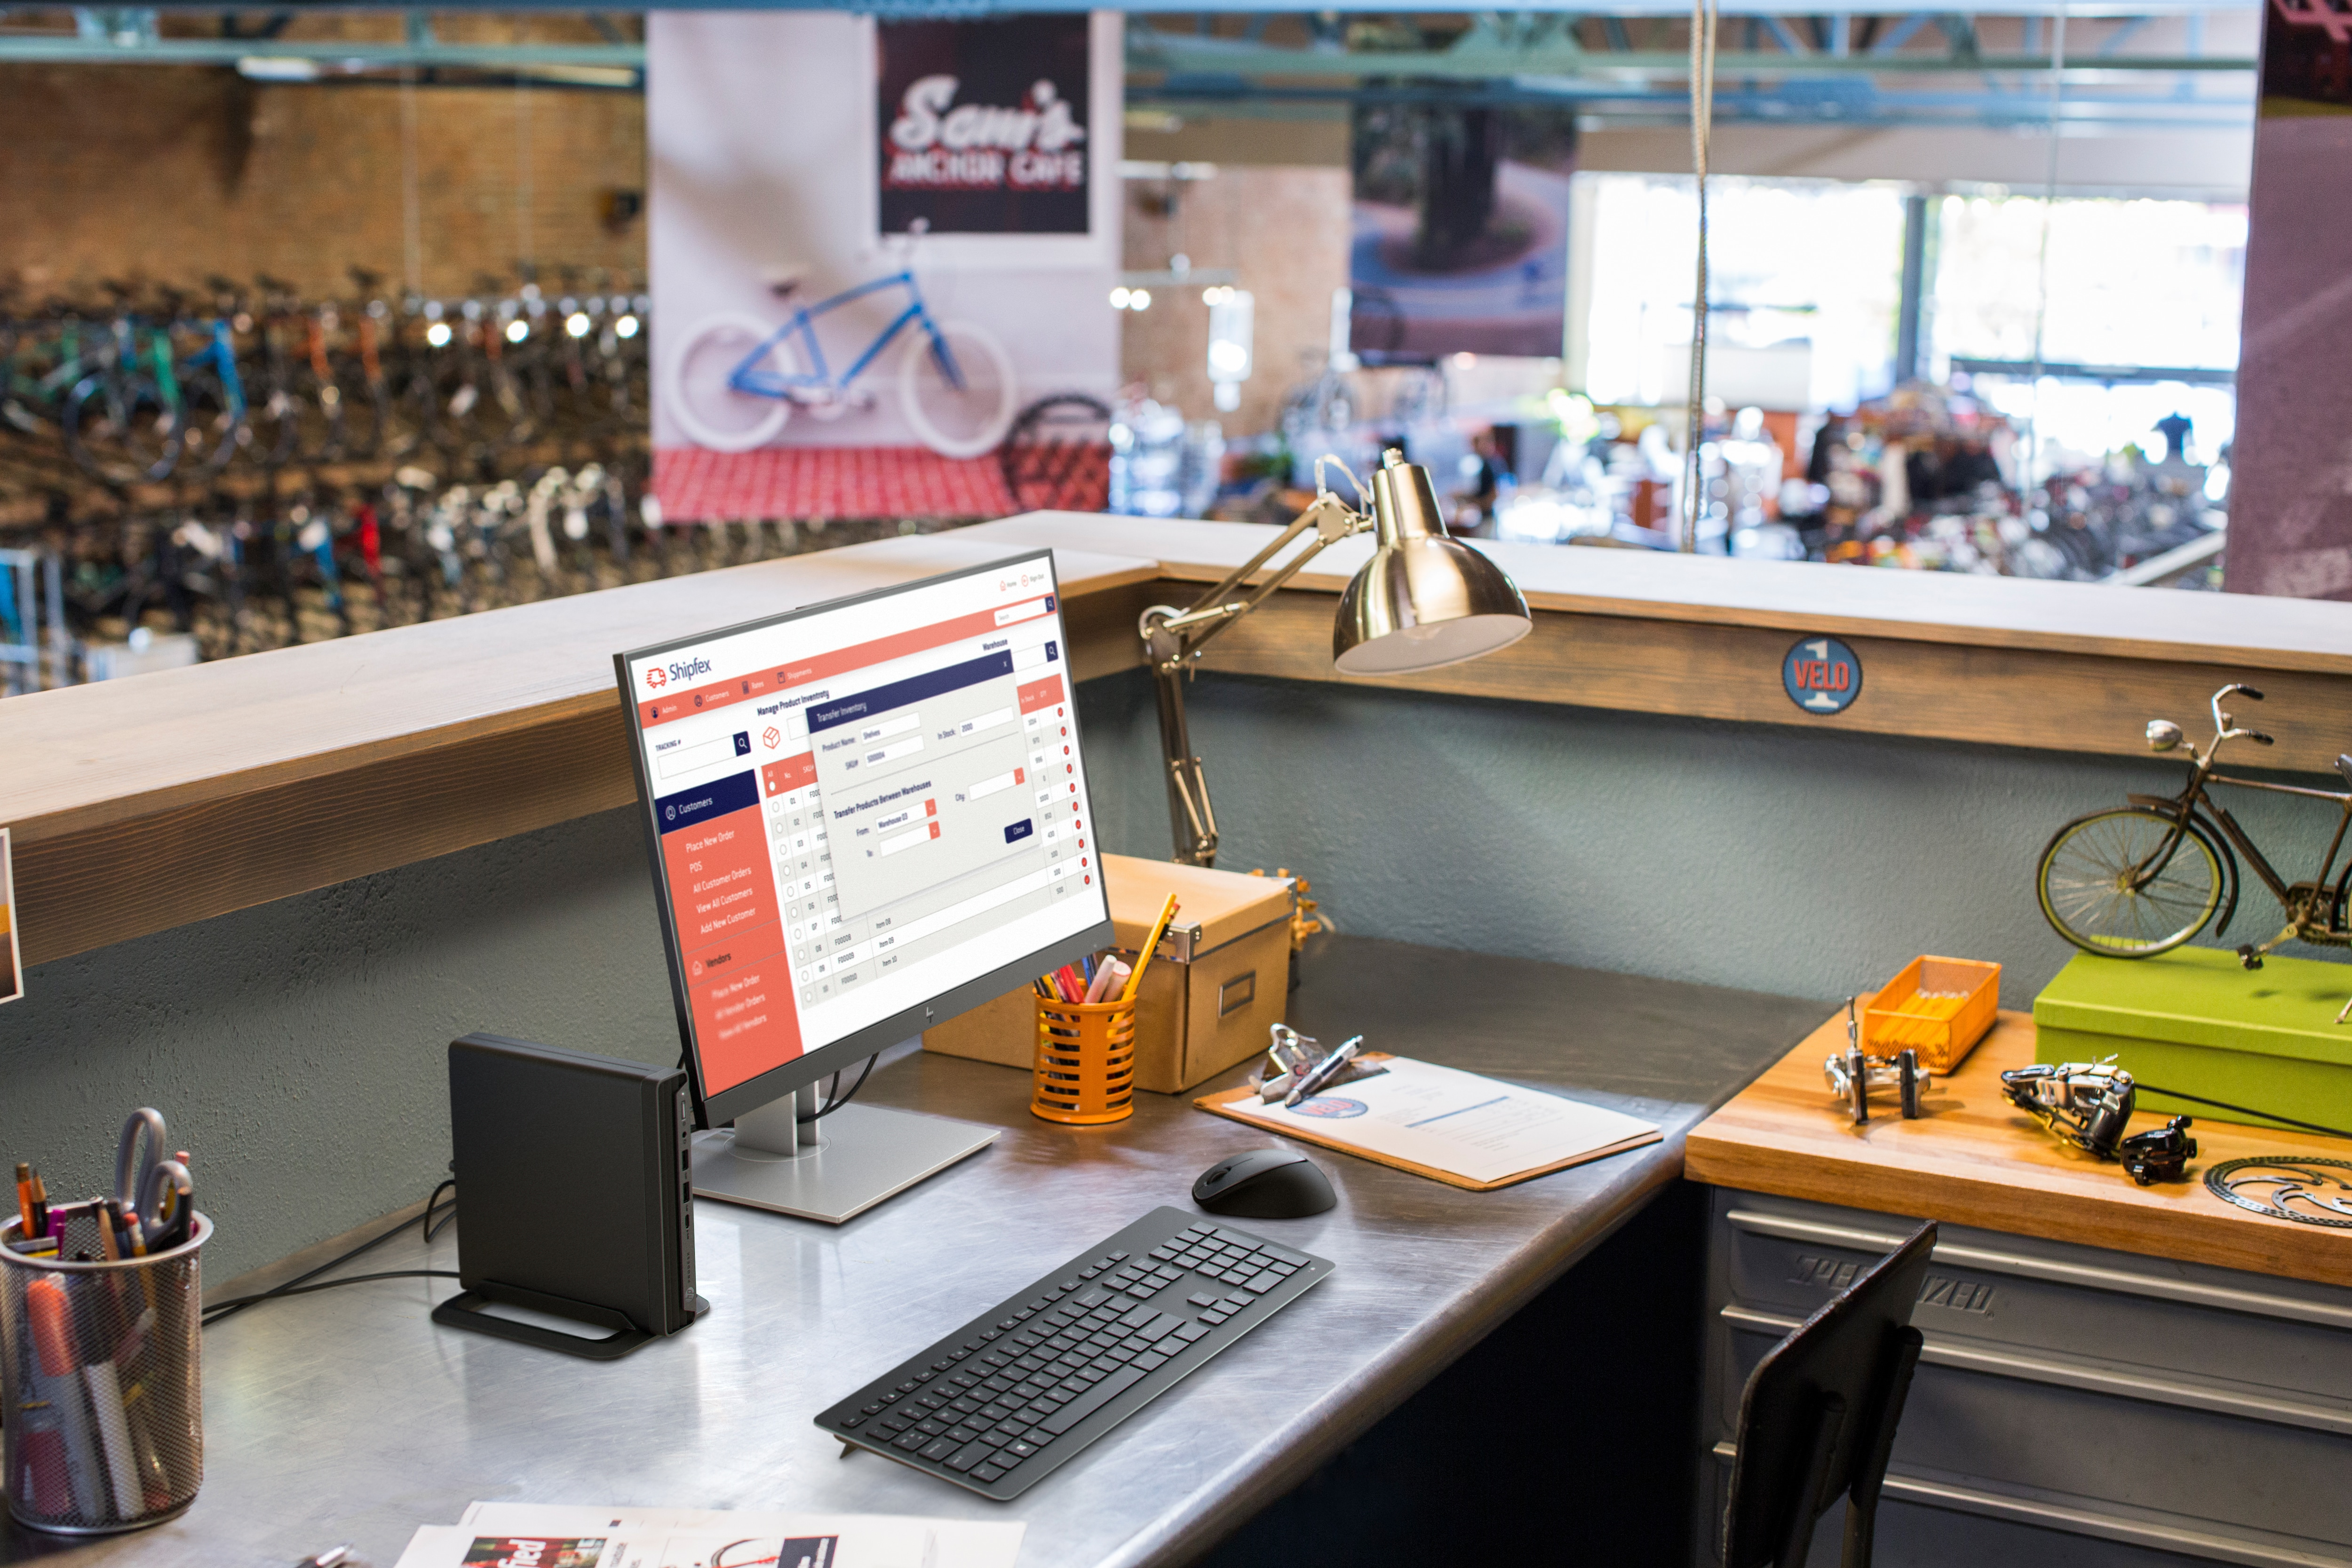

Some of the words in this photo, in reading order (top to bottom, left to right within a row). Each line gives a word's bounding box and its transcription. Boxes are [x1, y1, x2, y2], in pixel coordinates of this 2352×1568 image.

[982, 639, 1008, 651] Warehouse
[669, 657, 712, 681] Shipfex
[1793, 659, 1850, 692] VELO
[751, 681, 764, 690] Rates
[705, 691, 729, 702] Customers
[662, 704, 678, 715] Admin
[757, 703, 779, 716] Manage
[779, 698, 801, 709] Product
[817, 708, 840, 723] Transfer
[655, 740, 677, 752] TRACKING
[822, 740, 841, 752] Product
[678, 797, 713, 815] Customers
[834, 807, 856, 820] Transfer
[856, 798, 879, 812] Products
[879, 791, 902, 804] Between
[901, 780, 932, 796] Warehouses
[1013, 826, 1025, 835] Close
[685, 841, 703, 853] Place
[704, 836, 718, 847] New
[718, 830, 735, 843] Order
[689, 861, 703, 873] POS
[693, 883, 702, 894] All
[702, 874, 731, 891] Customer
[731, 867, 752, 880] Orders
[696, 904, 712, 914] View
[712, 898, 721, 908] All
[720, 888, 753, 906] Customers
[700, 922, 713, 935] Add
[713, 919, 727, 930] New
[727, 907, 756, 925] Customer
[885, 917, 891, 926] 08
[706, 953, 731, 968] Vendors
